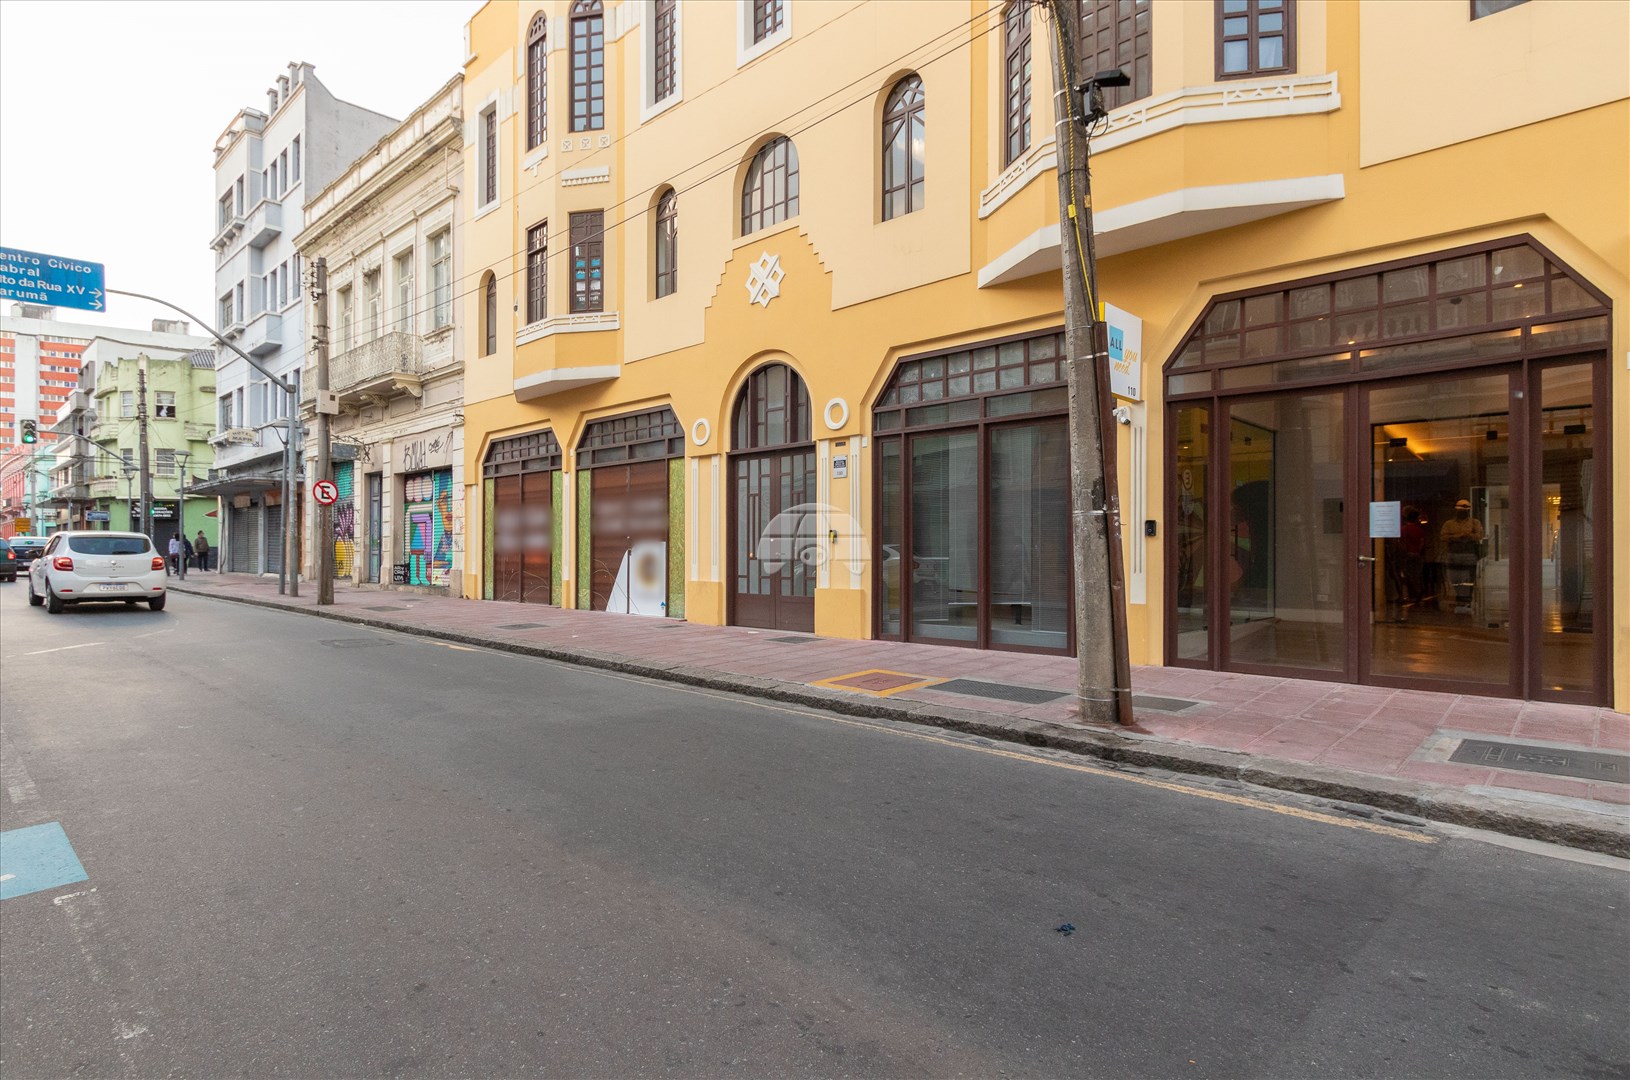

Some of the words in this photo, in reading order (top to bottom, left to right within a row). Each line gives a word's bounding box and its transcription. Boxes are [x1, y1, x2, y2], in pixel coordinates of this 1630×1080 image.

[48, 259, 91, 273] Cívico
[18, 278, 35, 288] da
[37, 280, 62, 292] Rua
[66, 284, 85, 295] XV
[1110, 337, 1122, 351] ALL
[1127, 386, 1137, 397] 110
